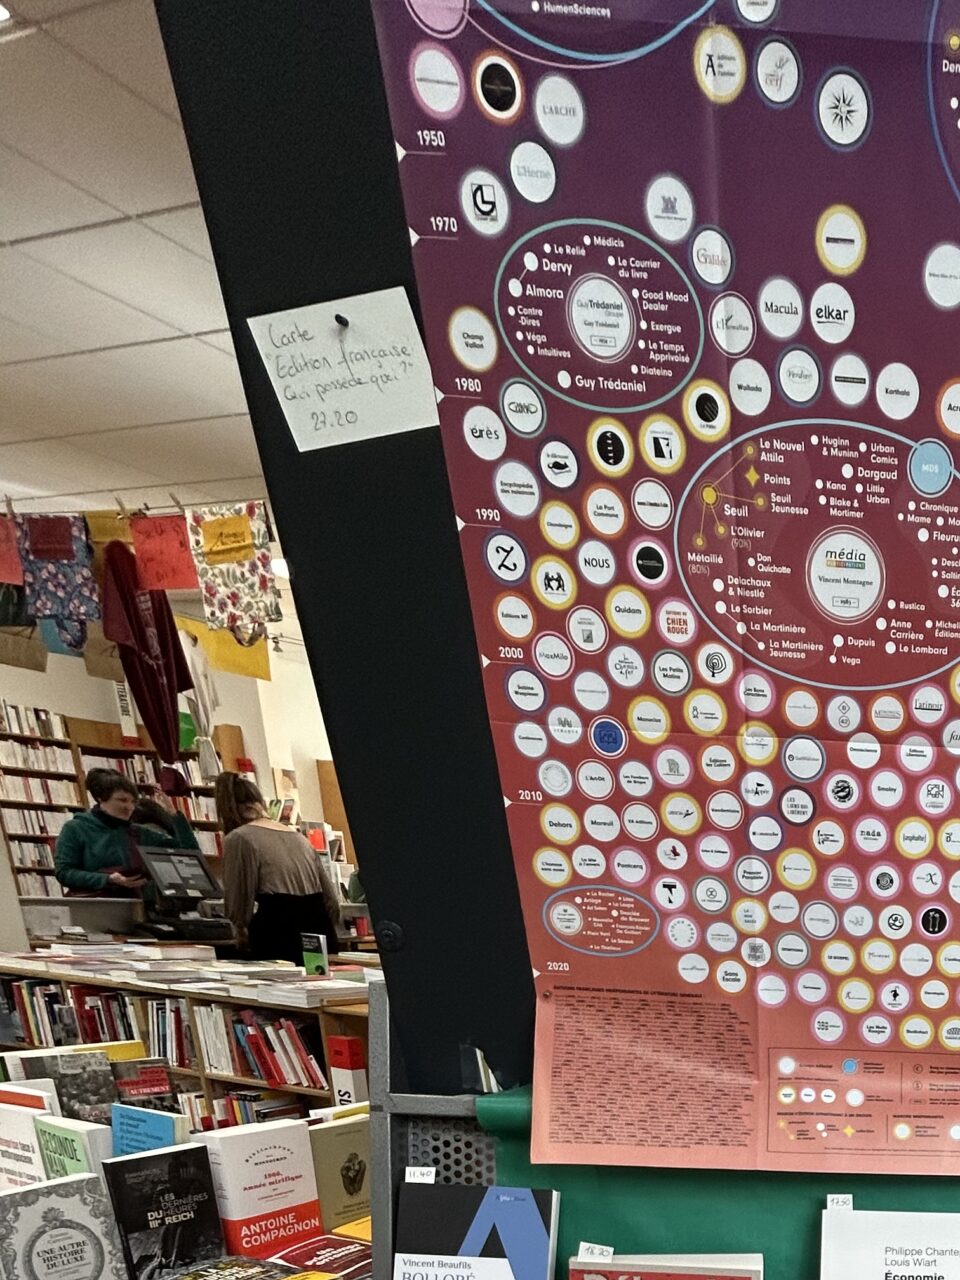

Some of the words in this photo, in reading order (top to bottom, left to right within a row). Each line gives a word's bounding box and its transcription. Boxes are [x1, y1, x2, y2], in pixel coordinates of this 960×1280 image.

[543, 2, 611, 18] HumenSciences
[417, 130, 446, 147] 1950
[430, 216, 458, 234] 1970
[542, 258, 572, 277] Dervy
[816, 304, 848, 320] elkar
[269, 324, 315, 348] Carte
[455, 377, 482, 393] 1980
[575, 376, 596, 391] Guy
[599, 377, 646, 393] Trédaniel
[857, 467, 898, 482] Dargaud
[475, 508, 500, 522] 1990
[825, 548, 866, 562] média
[584, 557, 610, 569] NOUS
[666, 616, 688, 627] CHIEN
[667, 626, 689, 635] ROUGE
[499, 647, 523, 659] 2000
[518, 790, 543, 802] 2010
[547, 961, 570, 971] 2020
[240, 1212, 297, 1236] ANTOINE
[242, 1217, 320, 1249] COMPAGNON
[884, 1246, 923, 1259] Philippe
[402, 1258, 435, 1269] Vincent
[437, 1260, 472, 1270] Beaufils
